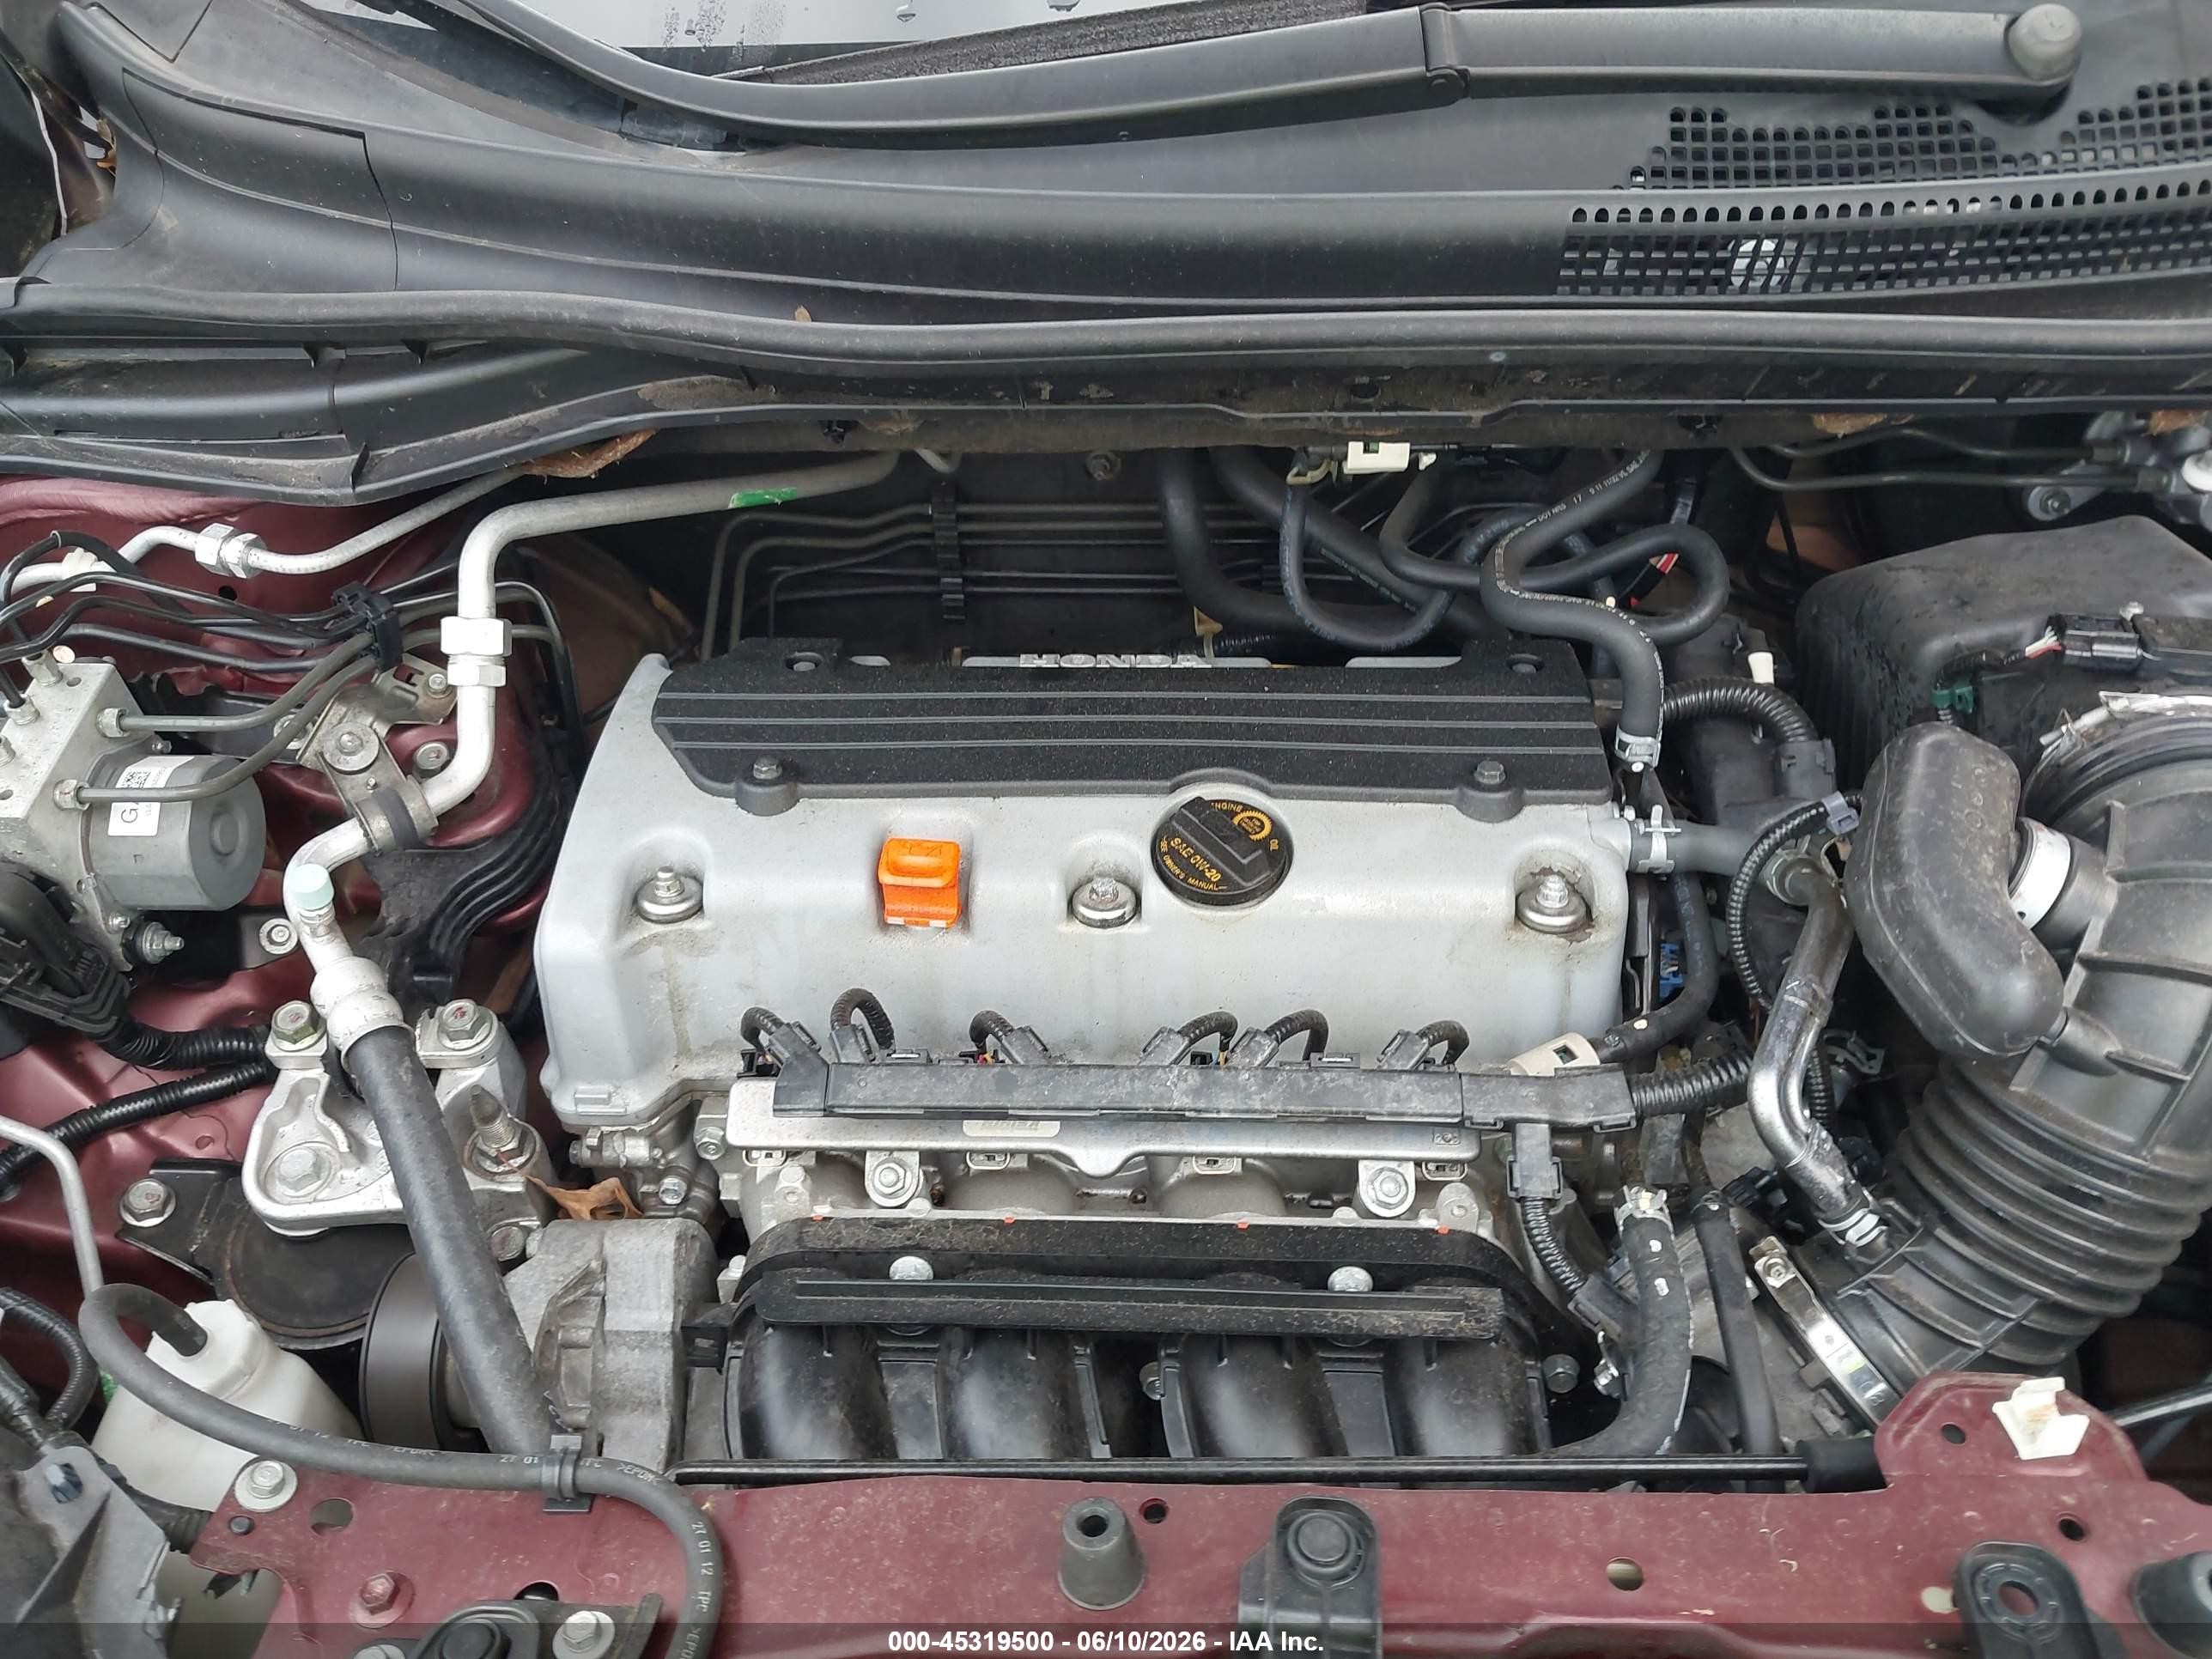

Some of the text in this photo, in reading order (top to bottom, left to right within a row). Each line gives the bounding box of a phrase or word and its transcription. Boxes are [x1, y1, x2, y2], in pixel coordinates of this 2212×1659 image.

[1018, 653, 1212, 668] HONDA
[1211, 802, 1243, 813] NGINE
[1163, 854, 1185, 879] OWNER'S
[1170, 837, 1222, 882] SAE 0W-20
[697, 1540, 713, 1553] 01
[701, 1561, 714, 1576] 12
